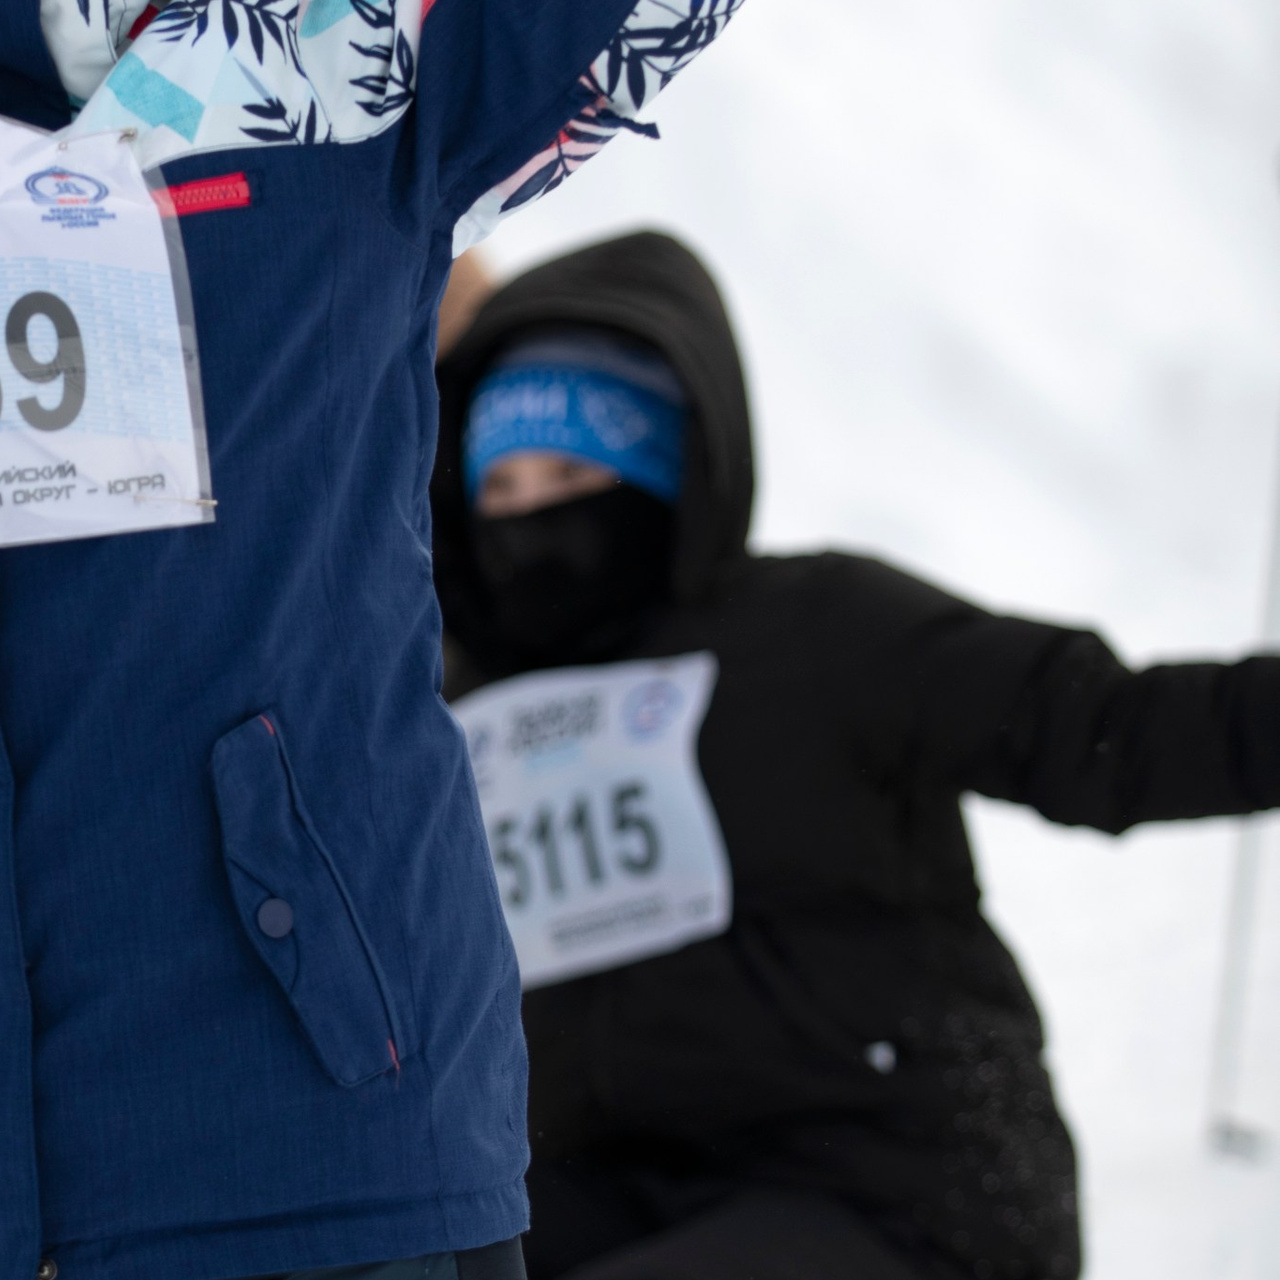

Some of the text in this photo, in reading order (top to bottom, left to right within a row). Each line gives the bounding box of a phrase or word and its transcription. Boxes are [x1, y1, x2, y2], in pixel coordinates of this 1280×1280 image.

[13, 484, 76, 505] ОКРУГ
[108, 473, 166, 495] ЮГРА
[490, 778, 661, 912] 5115
